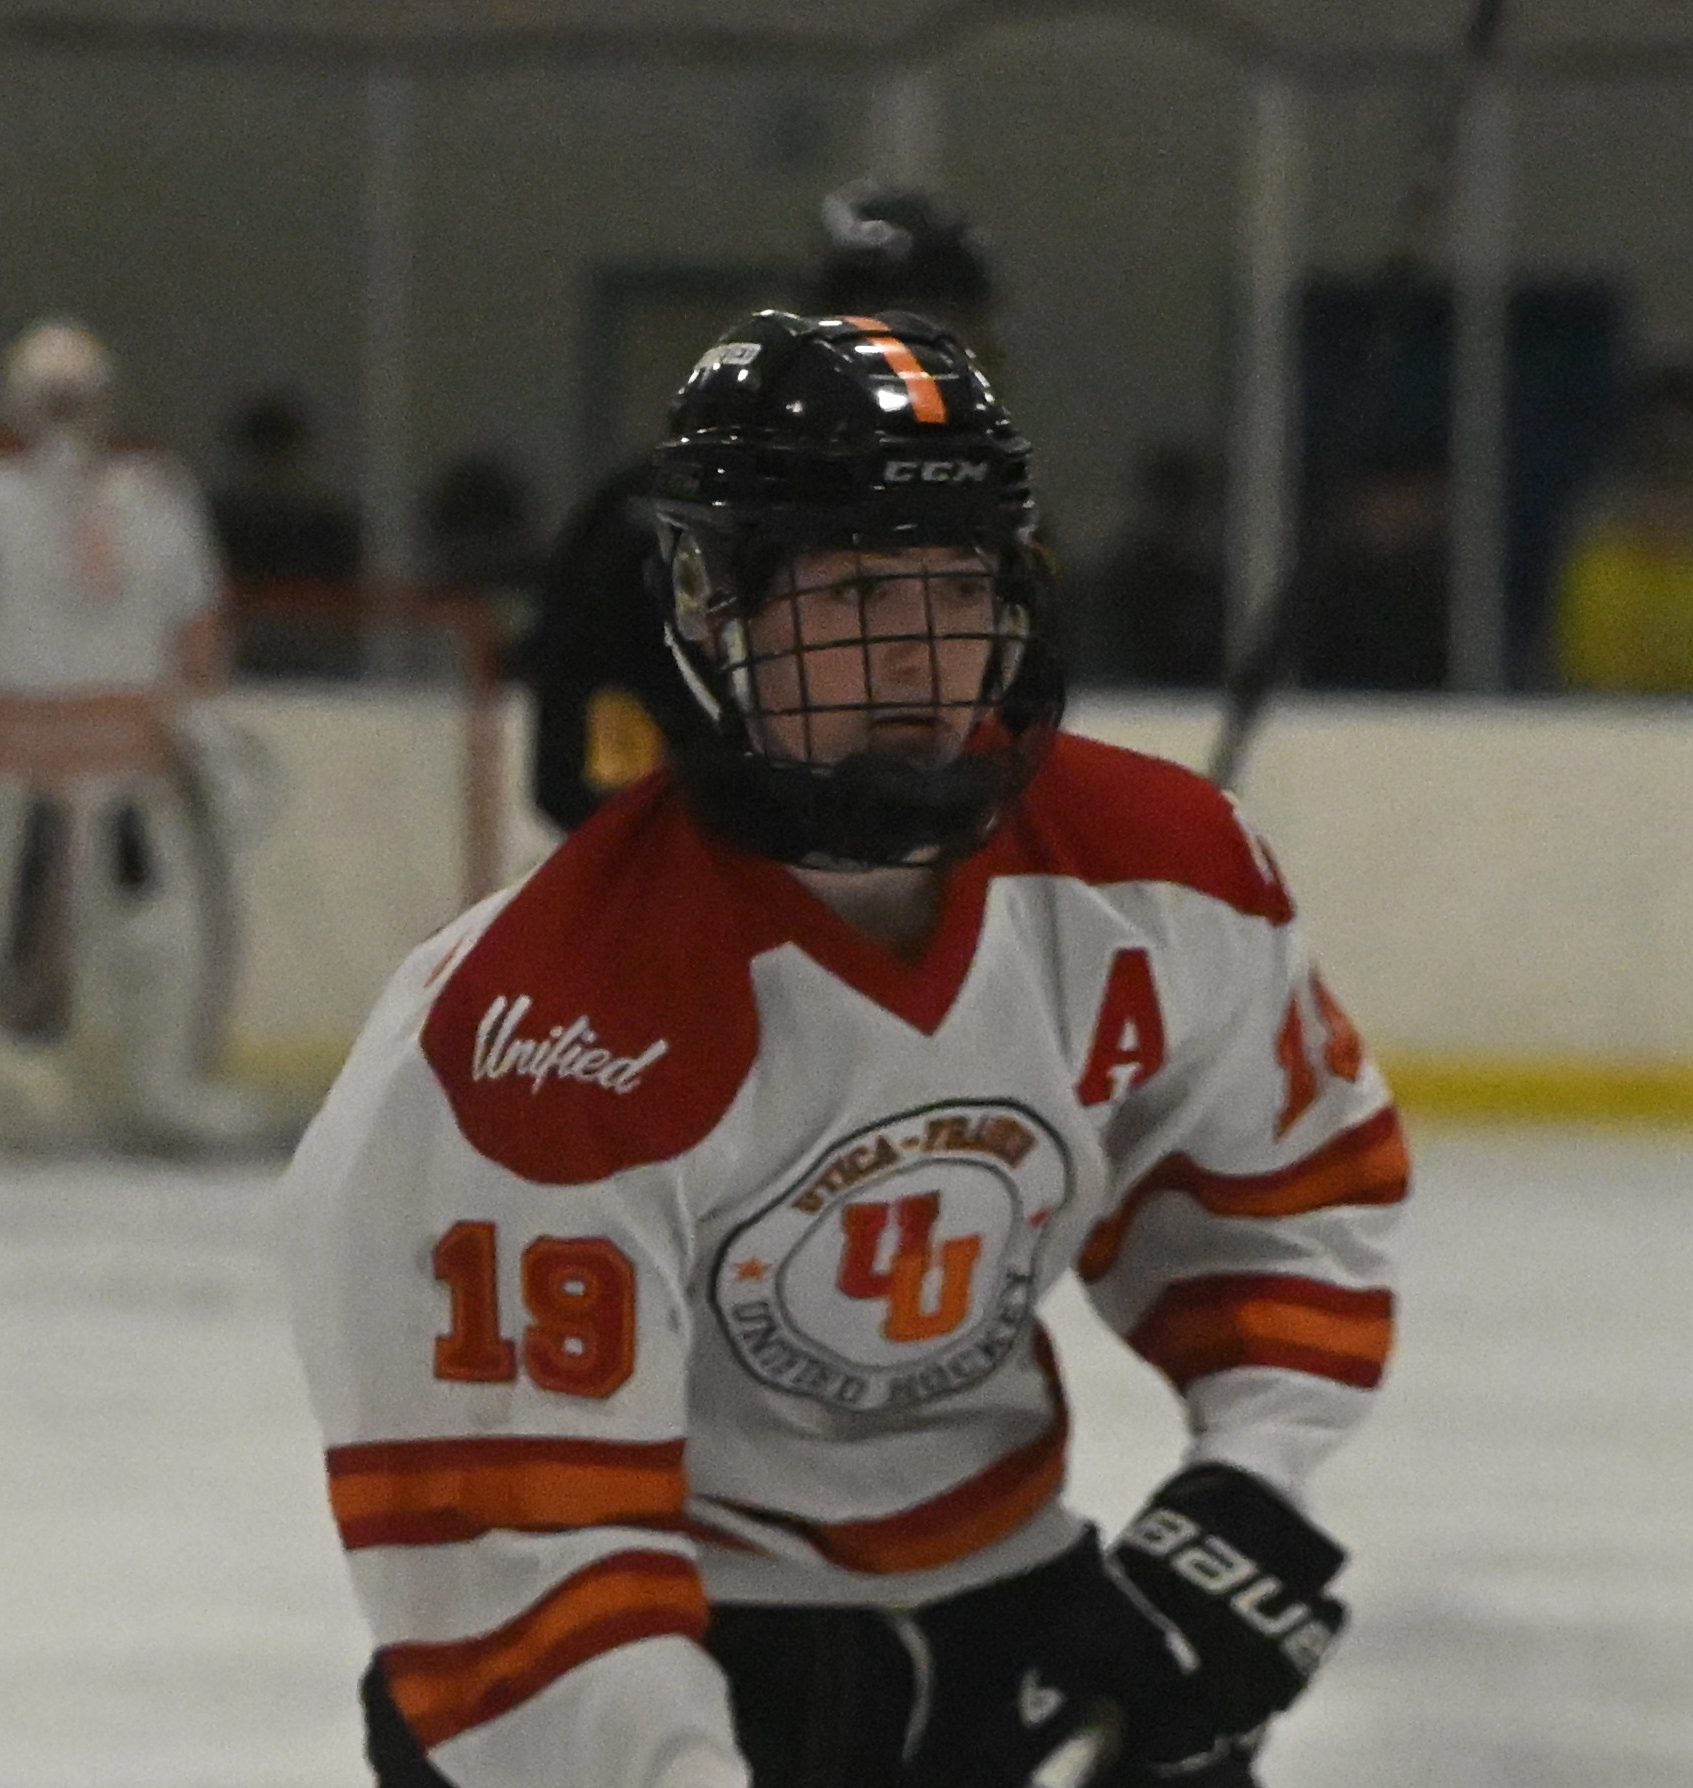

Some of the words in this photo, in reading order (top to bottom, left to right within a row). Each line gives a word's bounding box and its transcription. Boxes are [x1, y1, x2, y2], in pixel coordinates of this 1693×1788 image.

[883, 460, 988, 482] CCM
[473, 995, 668, 1094] Unified
[1075, 946, 1167, 1106] A
[432, 1218, 637, 1400] 19
